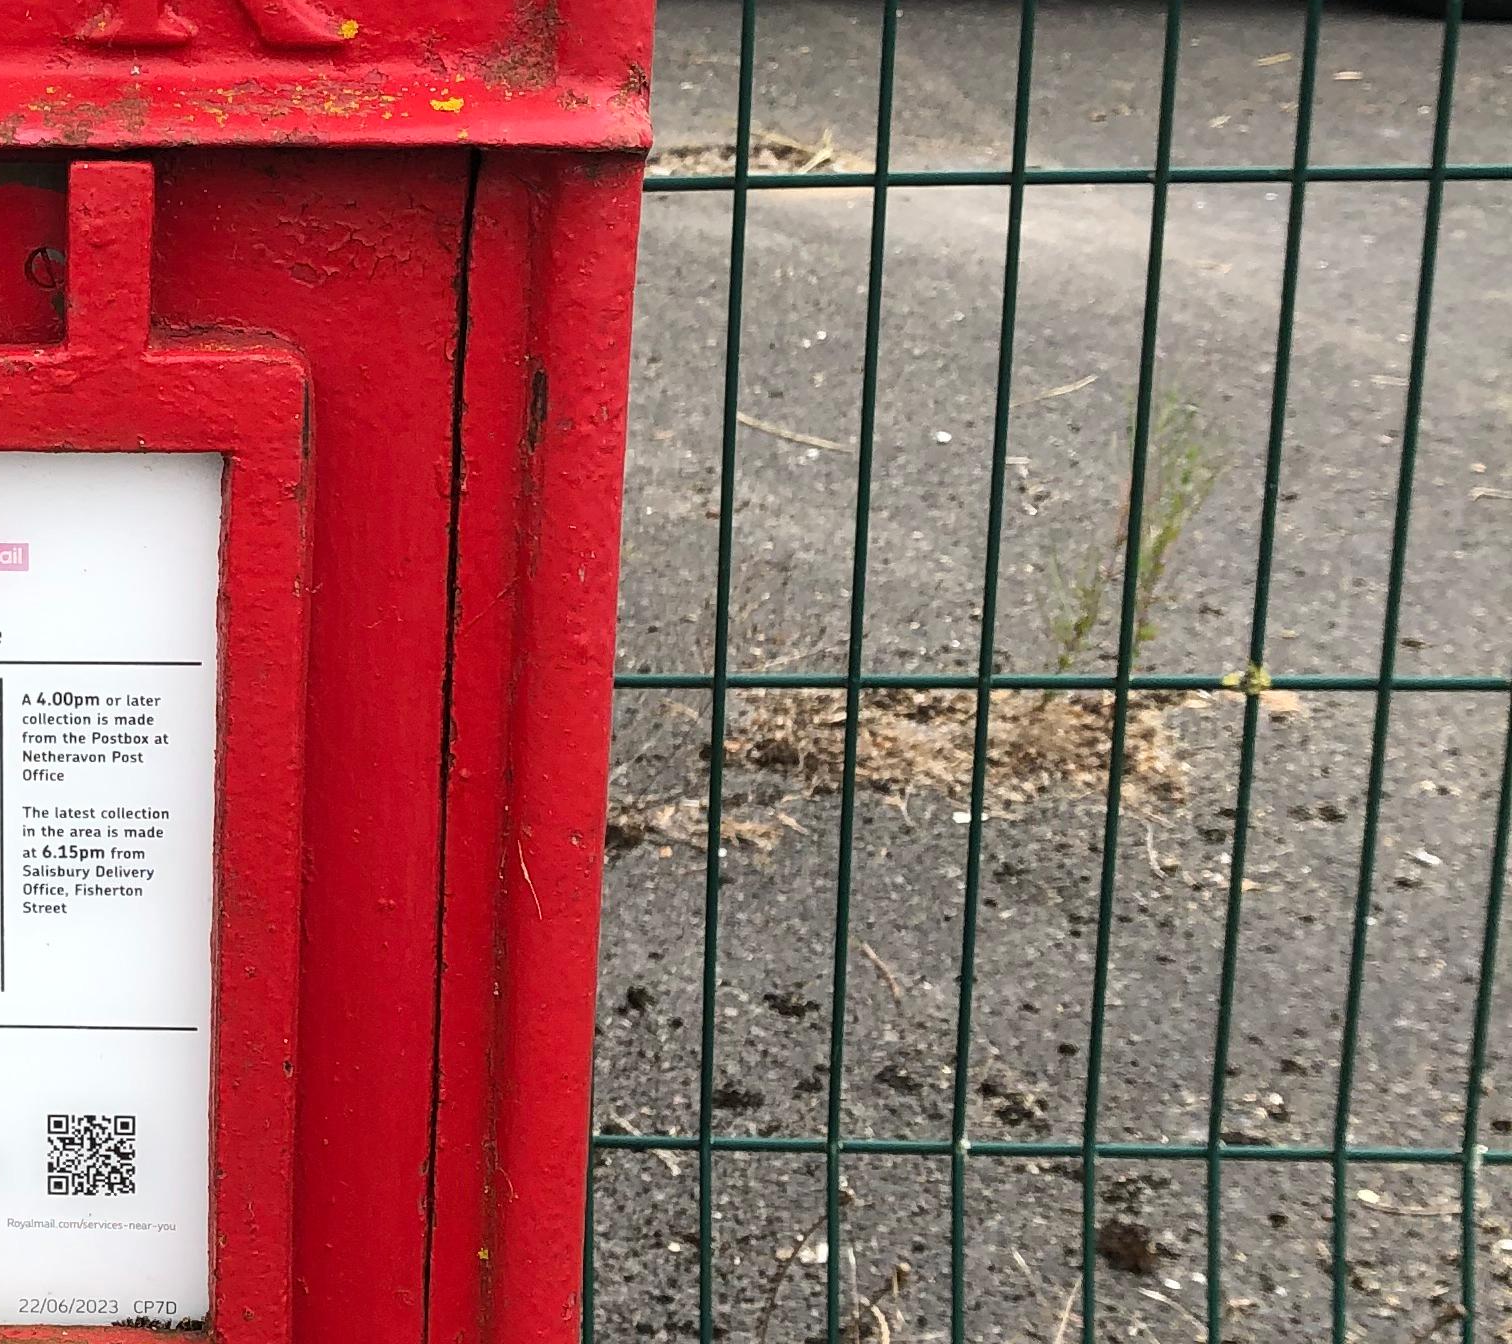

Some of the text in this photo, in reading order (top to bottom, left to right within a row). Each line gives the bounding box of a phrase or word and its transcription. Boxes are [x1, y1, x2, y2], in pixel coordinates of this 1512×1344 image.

[21, 691, 162, 710] A 4.00pm or later
[22, 712, 155, 726] collection is made
[22, 731, 169, 745] from the Postbox at
[22, 749, 144, 764] Netheravon Post
[22, 768, 65, 782] Office
[21, 805, 170, 820] The latest collection
[22, 824, 164, 839] in the area is made
[22, 844, 145, 862] at 6.15pm from
[22, 864, 155, 881] Salisbury Delivery
[22, 883, 143, 898] Office, Fisherton
[22, 901, 68, 914] Street
[18, 1297, 119, 1315] 22/06/2023
[133, 1300, 177, 1316] CP7D
